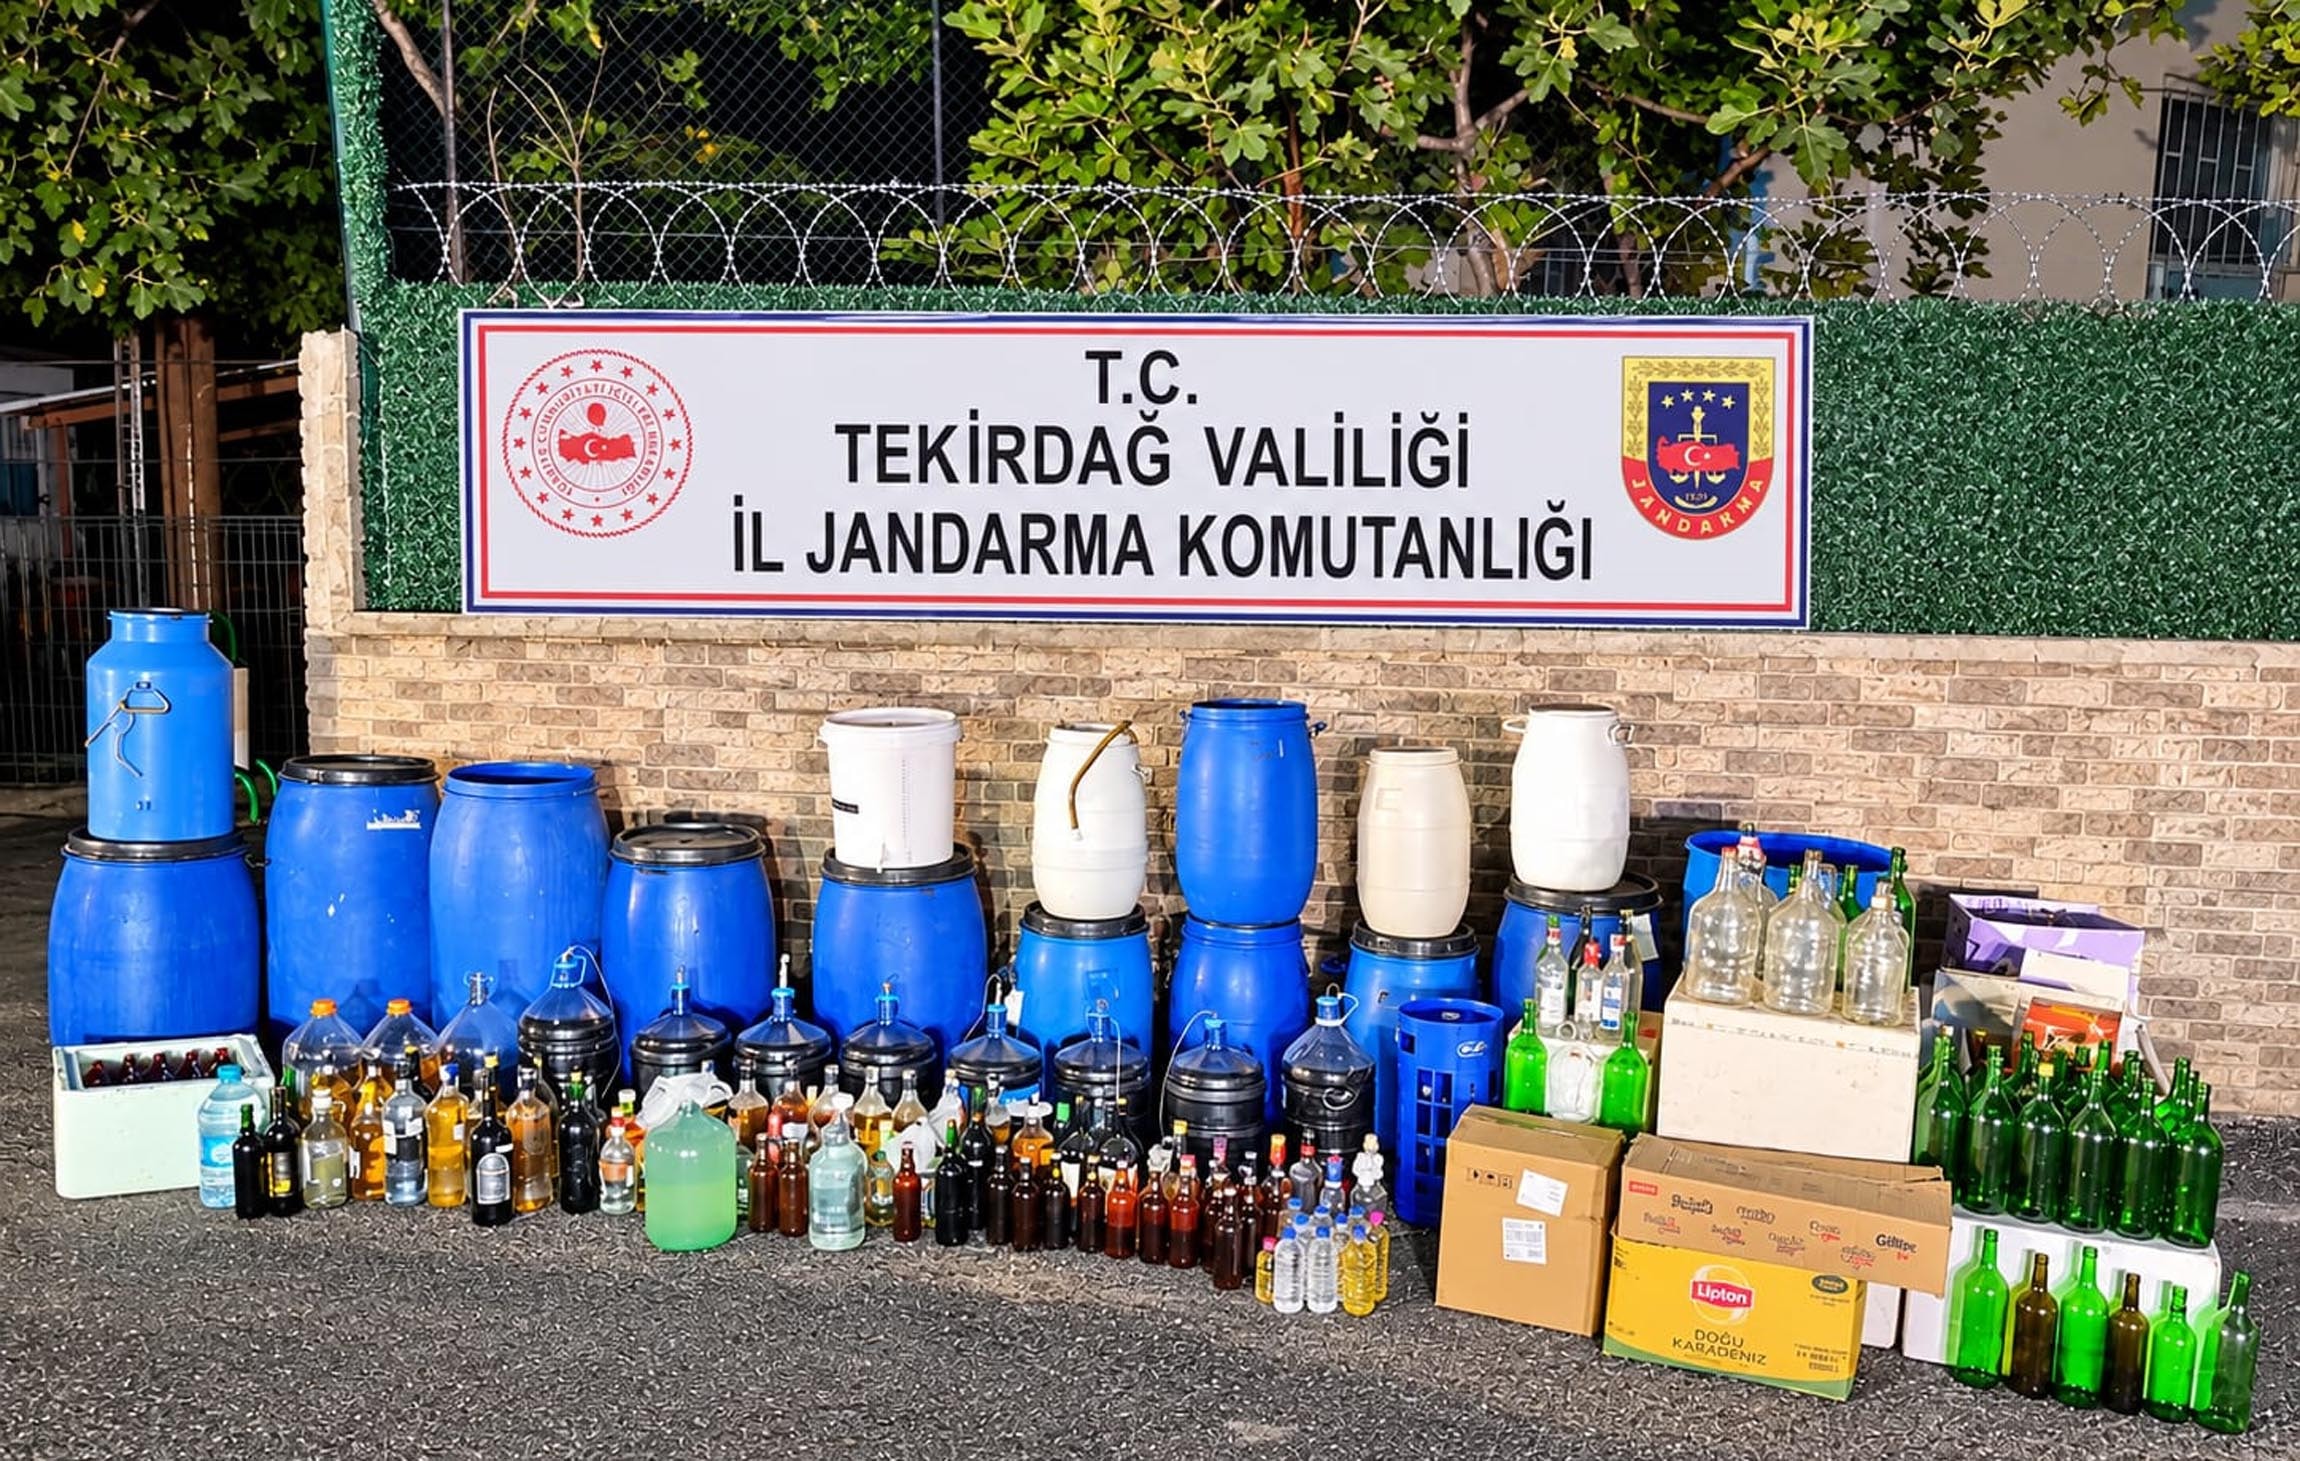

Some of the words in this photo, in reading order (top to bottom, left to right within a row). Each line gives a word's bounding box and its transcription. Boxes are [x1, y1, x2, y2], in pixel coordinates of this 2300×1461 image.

[1085, 349, 1197, 405] T.C.
[834, 408, 1170, 486] TEKİRDAĞ
[1203, 411, 1468, 489] VALİLİĞİ
[1632, 479, 1764, 534] JANDARMA
[734, 494, 784, 572] İL
[806, 511, 1155, 576] JANDARMA
[1179, 499, 1592, 581] KOMUTANLIĞI
[1697, 1283, 1747, 1304] Lipton
[1694, 1329, 1744, 1348] DOĞU
